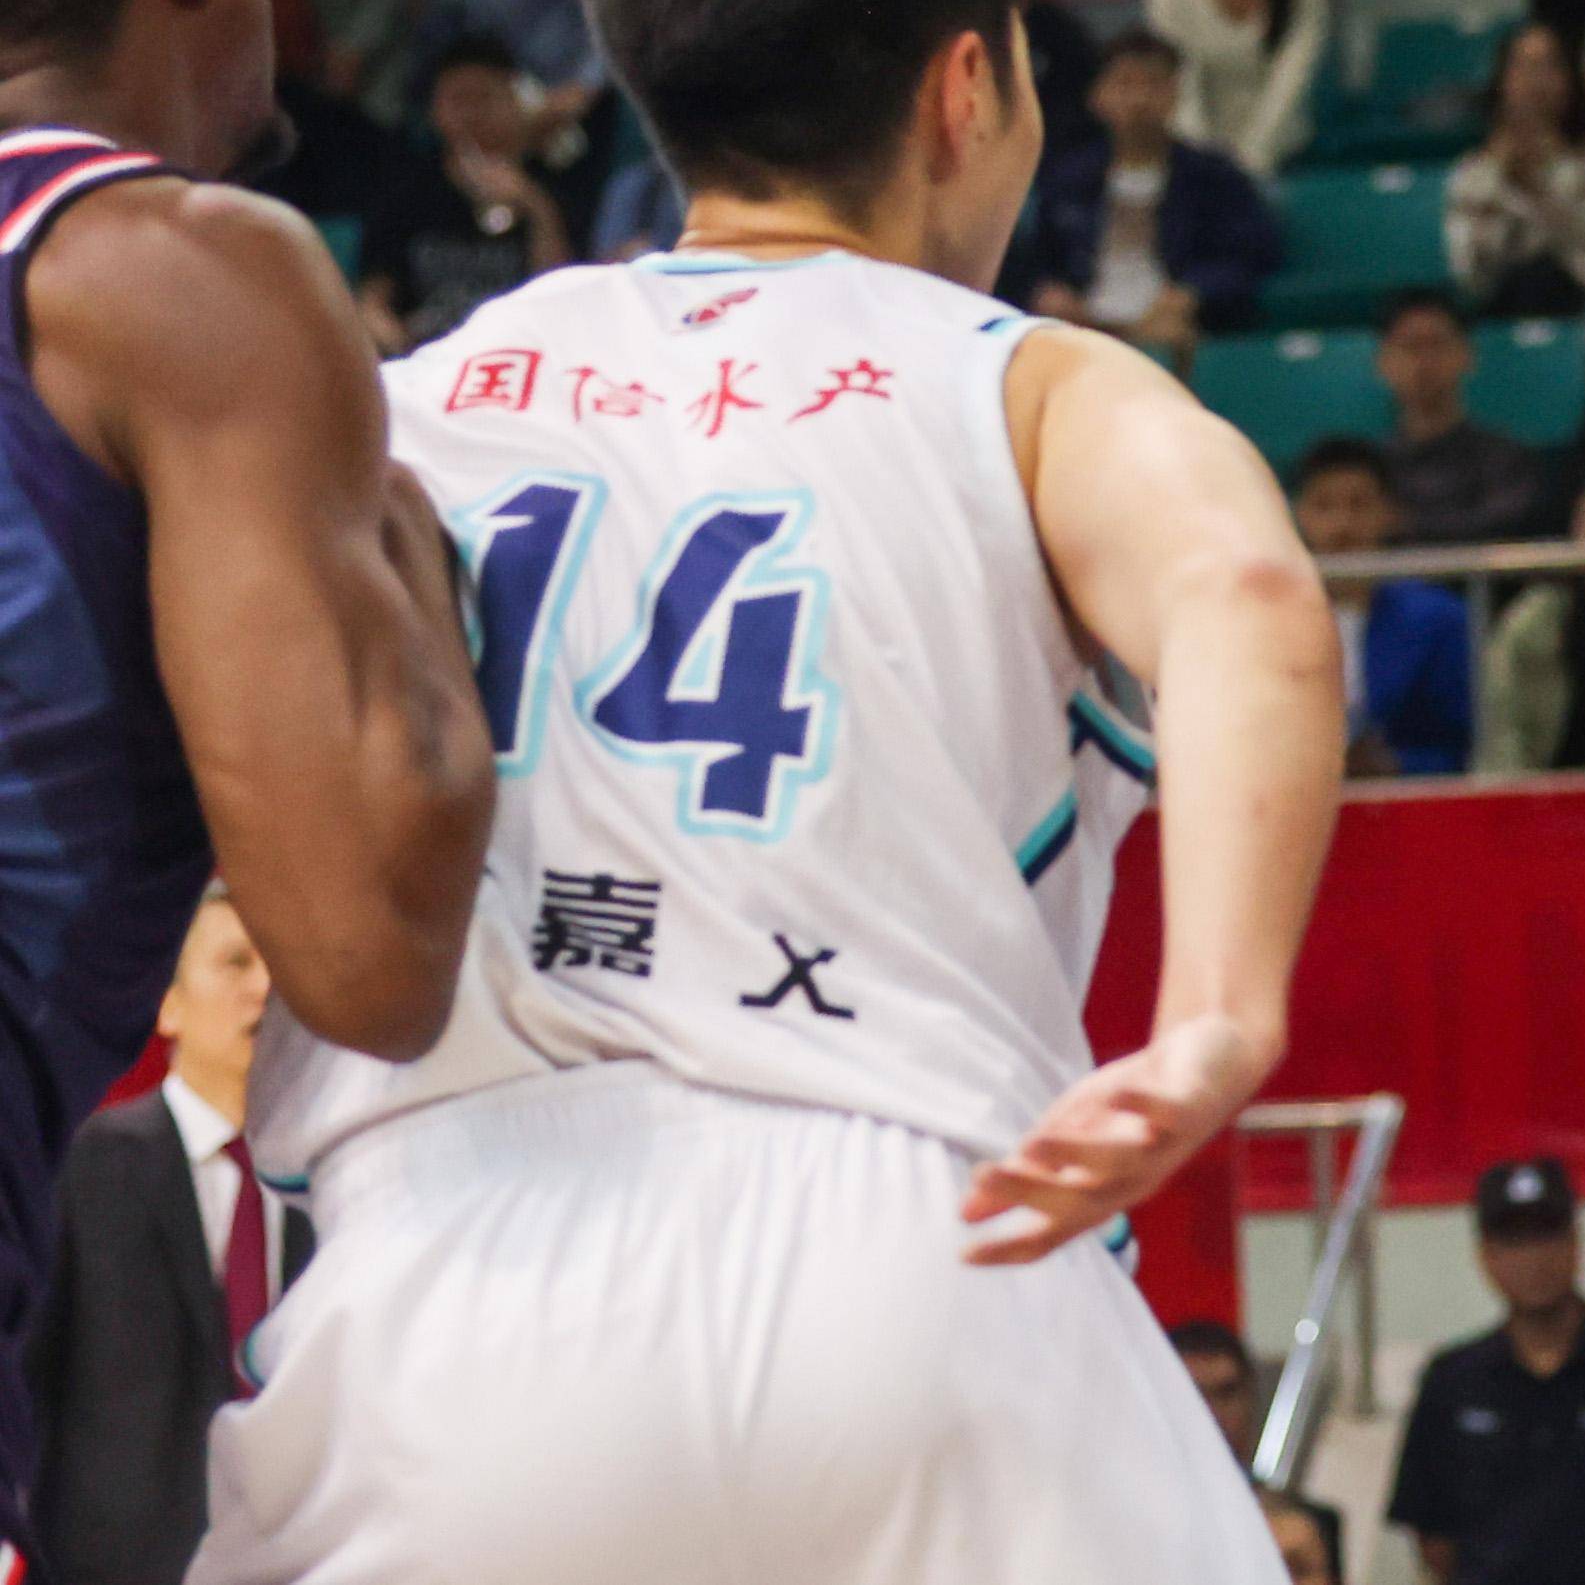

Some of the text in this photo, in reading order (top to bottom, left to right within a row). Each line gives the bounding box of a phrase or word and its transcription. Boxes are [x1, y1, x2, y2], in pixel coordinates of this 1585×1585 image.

[443, 348, 893, 439] 国信水产
[462, 468, 842, 845] 14
